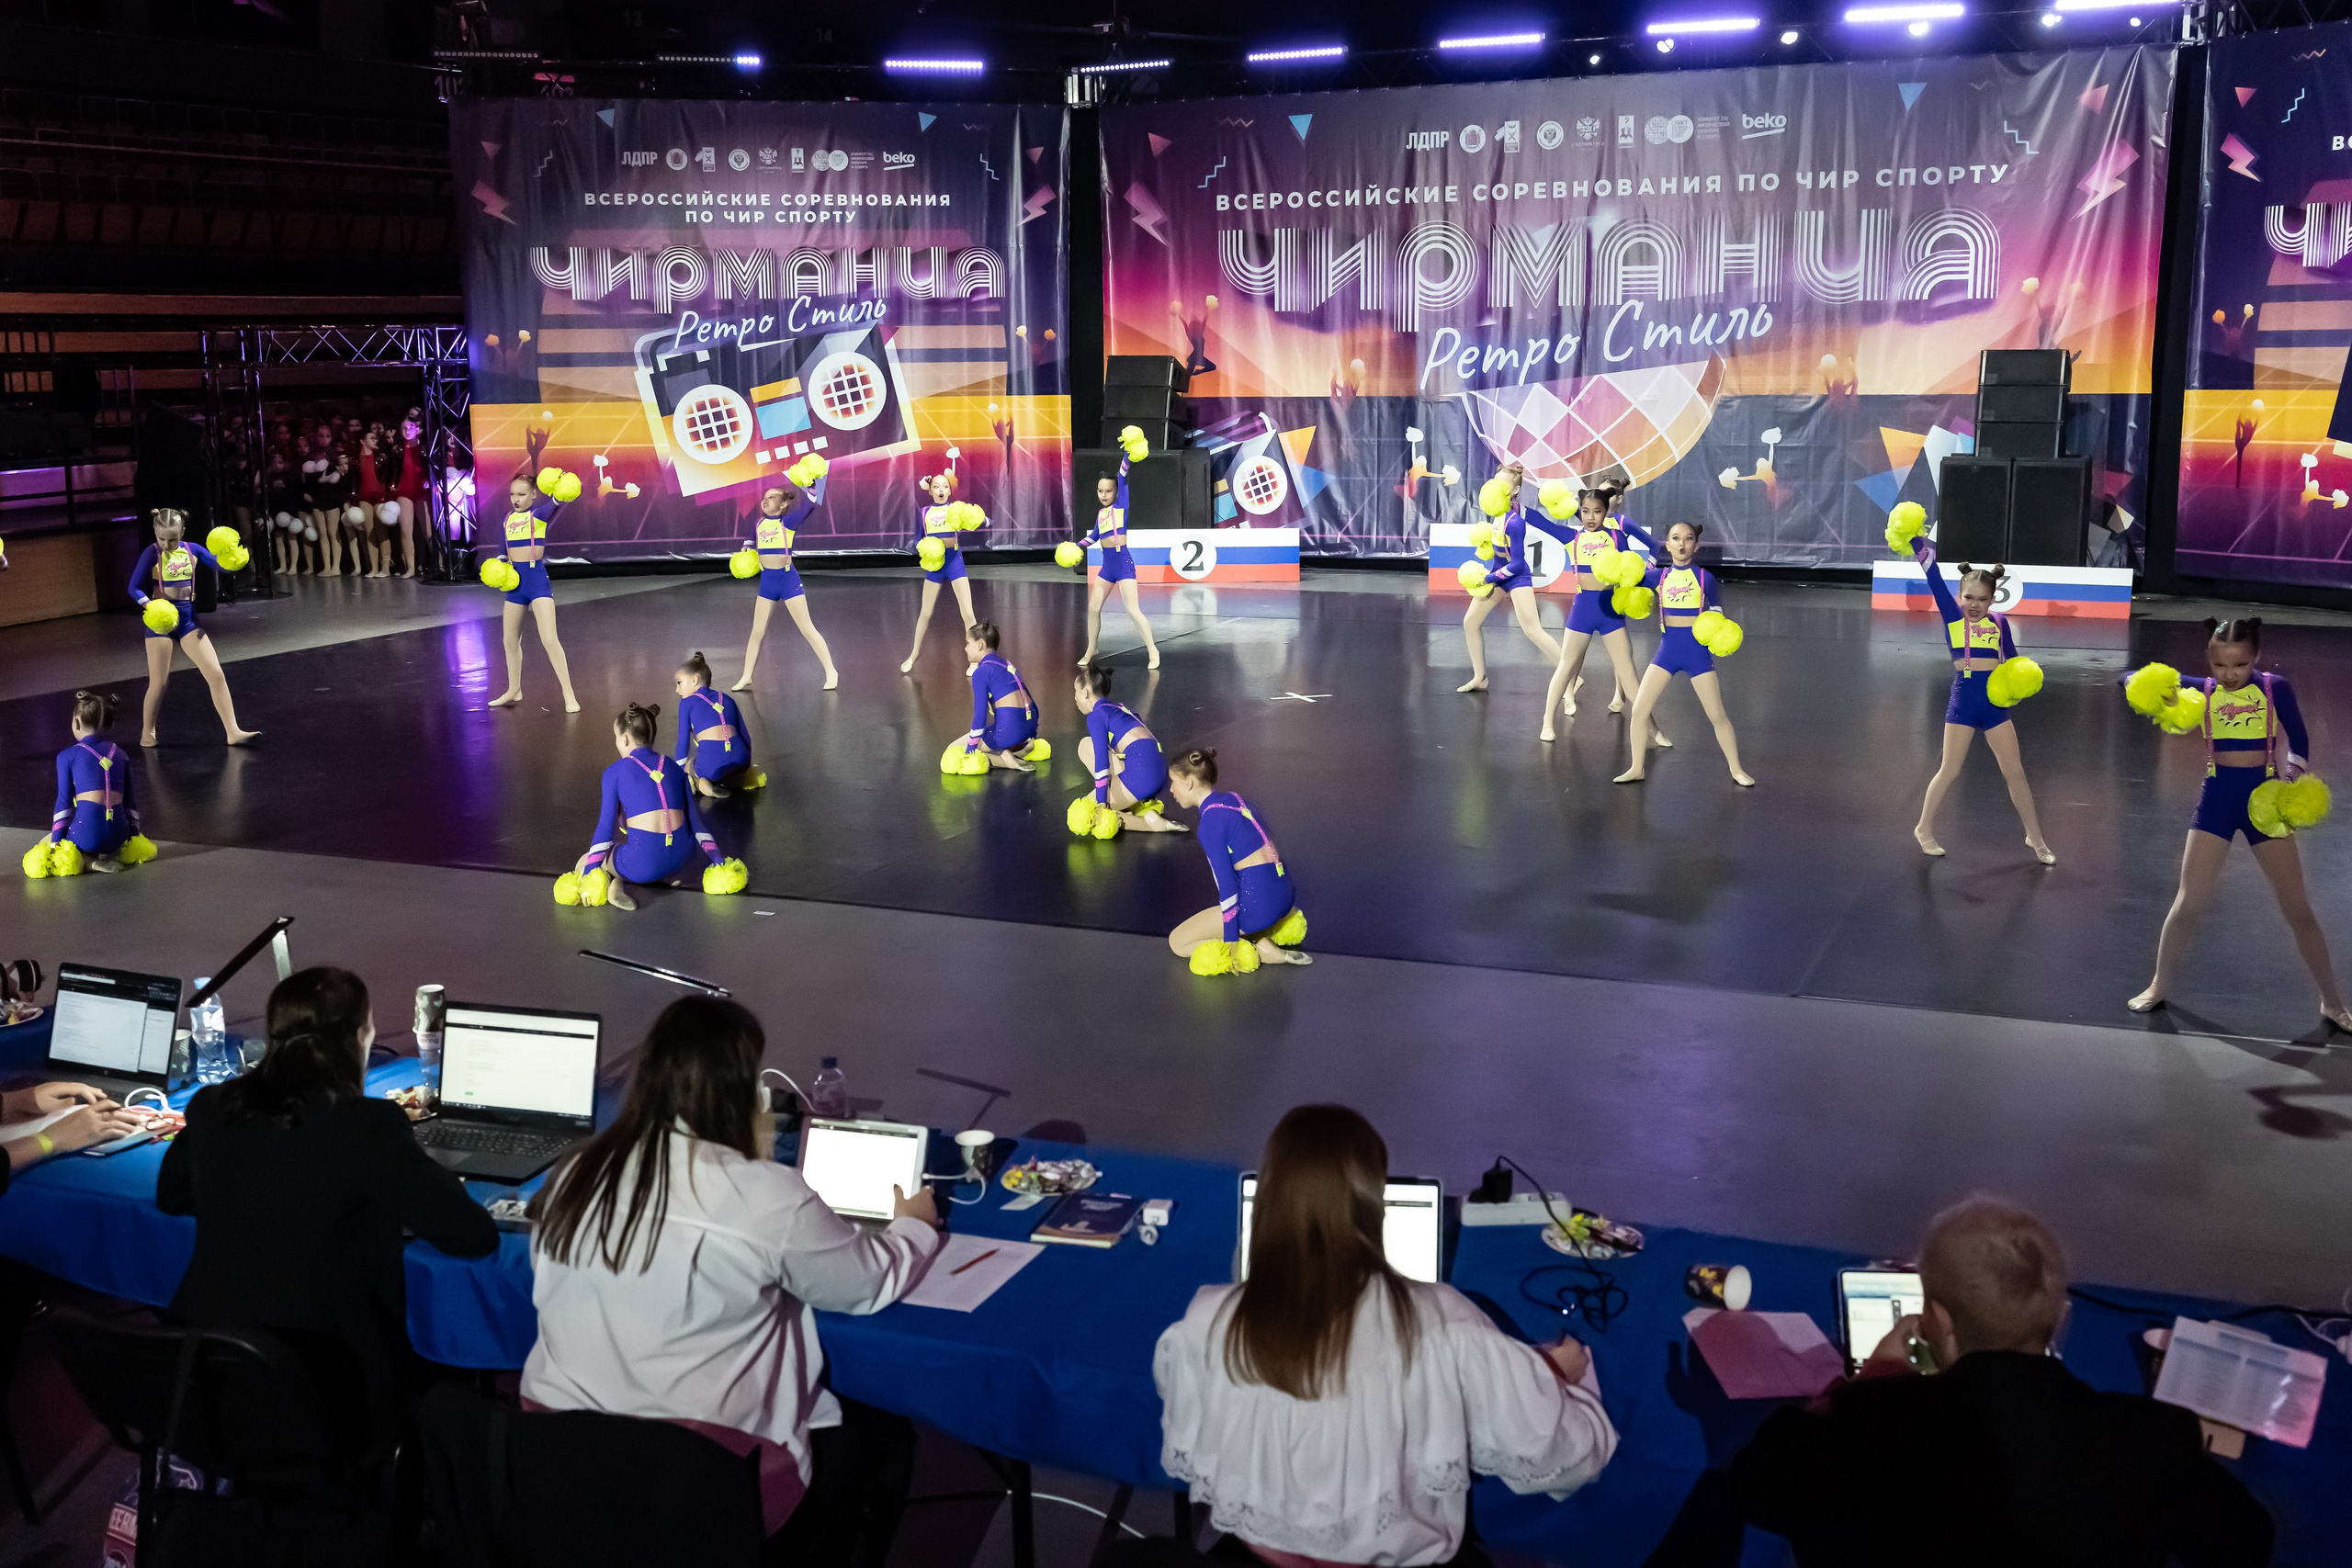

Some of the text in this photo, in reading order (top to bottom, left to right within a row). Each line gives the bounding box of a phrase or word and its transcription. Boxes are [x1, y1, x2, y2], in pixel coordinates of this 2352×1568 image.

[1742, 112, 1787, 129] beko
[1406, 130, 1450, 152] ЛДПР
[621, 151, 658, 166] ЛДПР
[883, 151, 915, 164] beko
[584, 190, 952, 208] ВСЕРОССИЙСКИЕ СОРЕВНОВАНИЯ
[1216, 164, 2009, 211] ВСЕРОССИЙСКИЕ СОРЕВНОВАНИЯ ПО ЧИР СПОРТУ
[685, 210, 857, 224] ПО ЧИР СПОРТУ
[673, 295, 888, 351] Ретро Стиль
[1420, 298, 1773, 390] Ретро Стиль
[1182, 540, 1204, 571] 2
[1527, 540, 1546, 577] 1
[1994, 575, 2011, 604] 3
